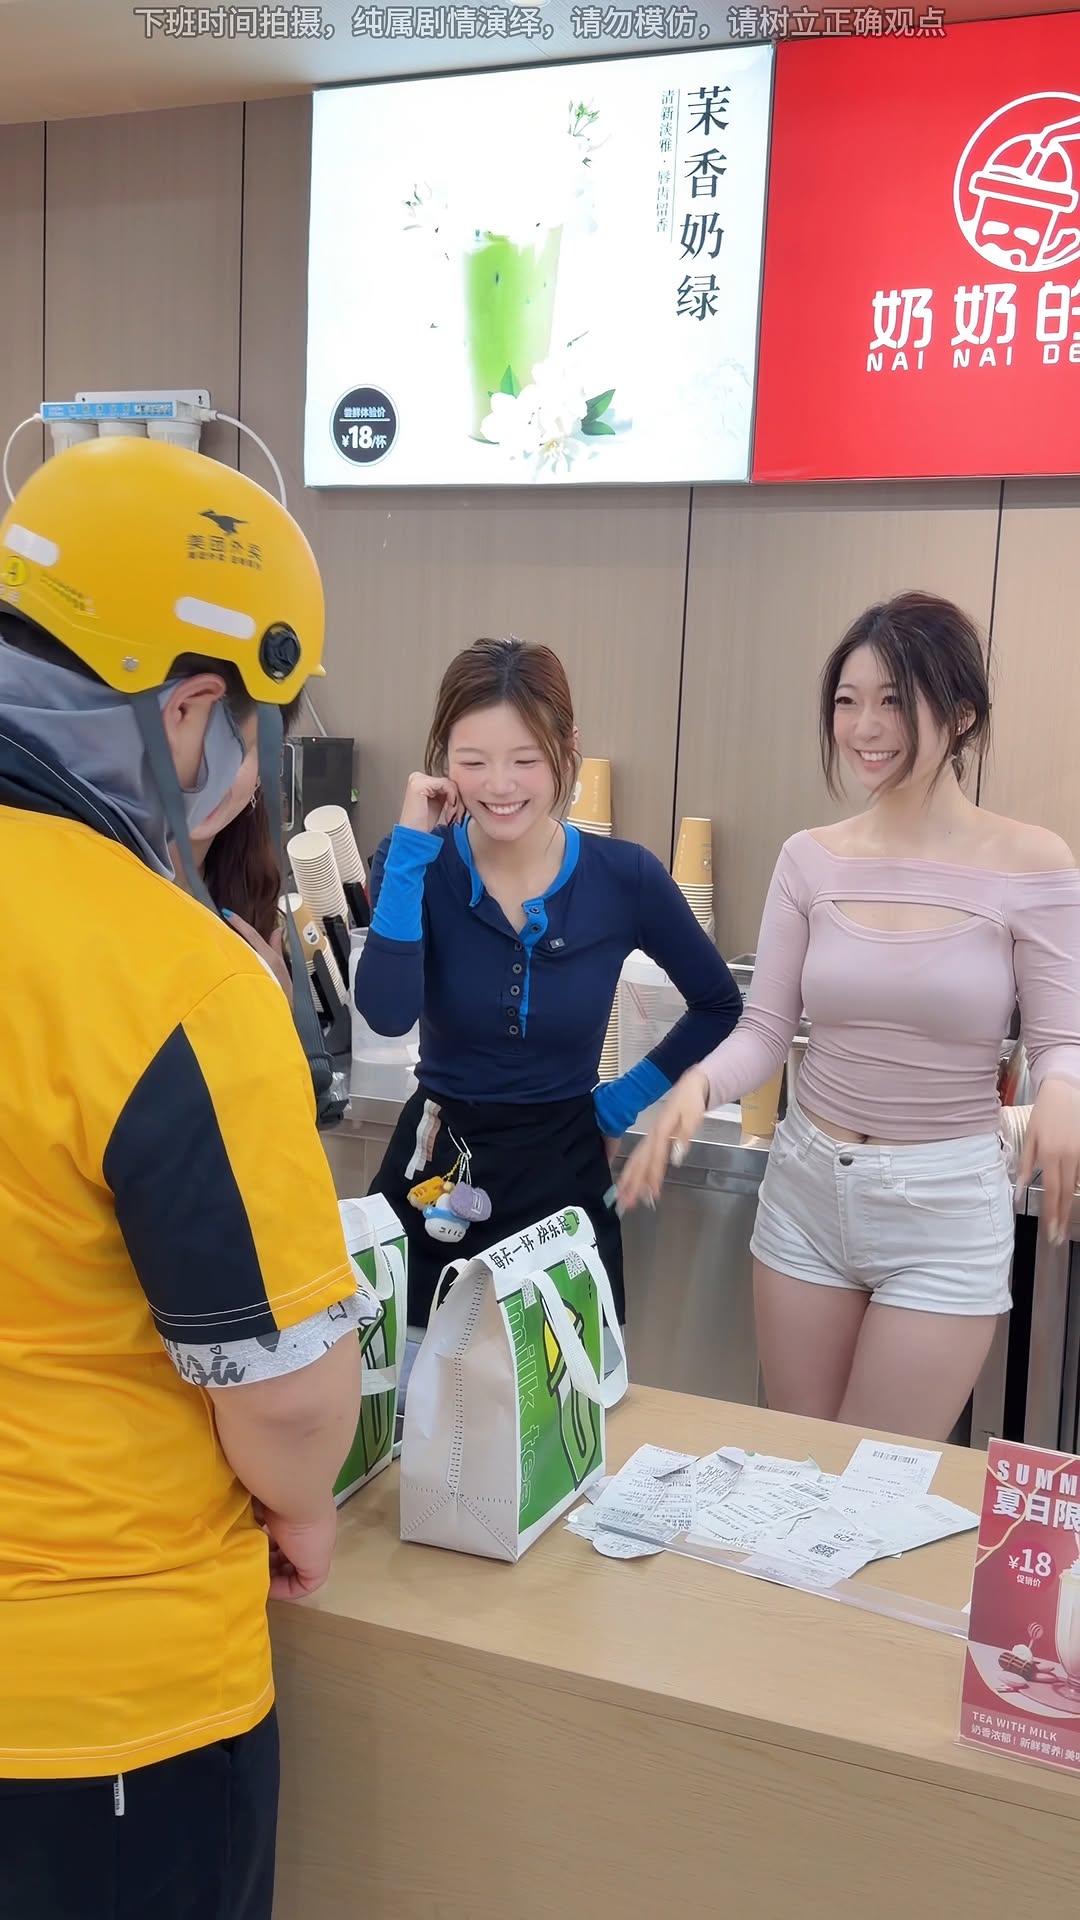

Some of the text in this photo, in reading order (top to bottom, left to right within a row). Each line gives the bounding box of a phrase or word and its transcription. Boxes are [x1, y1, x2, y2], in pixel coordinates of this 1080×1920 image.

[676, 86, 731, 322] 茉香奶绿
[866, 350, 925, 372] NAI
[952, 346, 1013, 369] NAI
[504, 1298, 539, 1416] milk
[1007, 1548, 1053, 1578] ¥18
[1016, 1574, 1042, 1588] 促销价
[972, 1711, 1058, 1742] TEA WITH MILK
